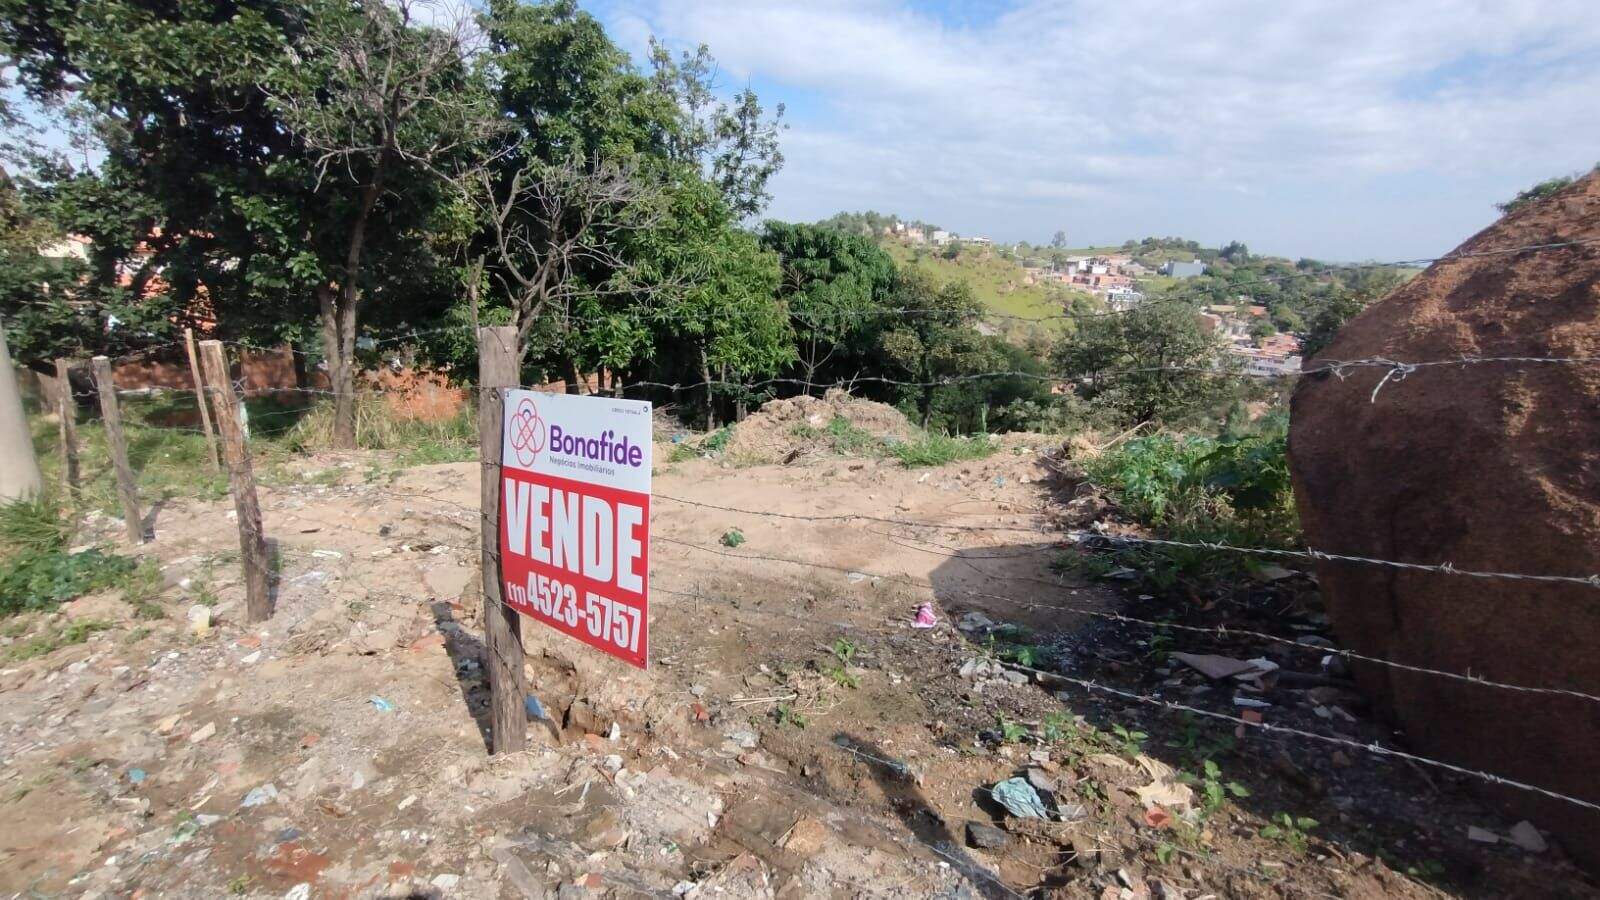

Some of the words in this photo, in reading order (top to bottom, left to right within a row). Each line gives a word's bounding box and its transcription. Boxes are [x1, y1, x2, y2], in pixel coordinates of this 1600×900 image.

[550, 425, 643, 468] Bonafide
[505, 477, 643, 594] VENDE
[527, 571, 641, 653] 4523-5757
